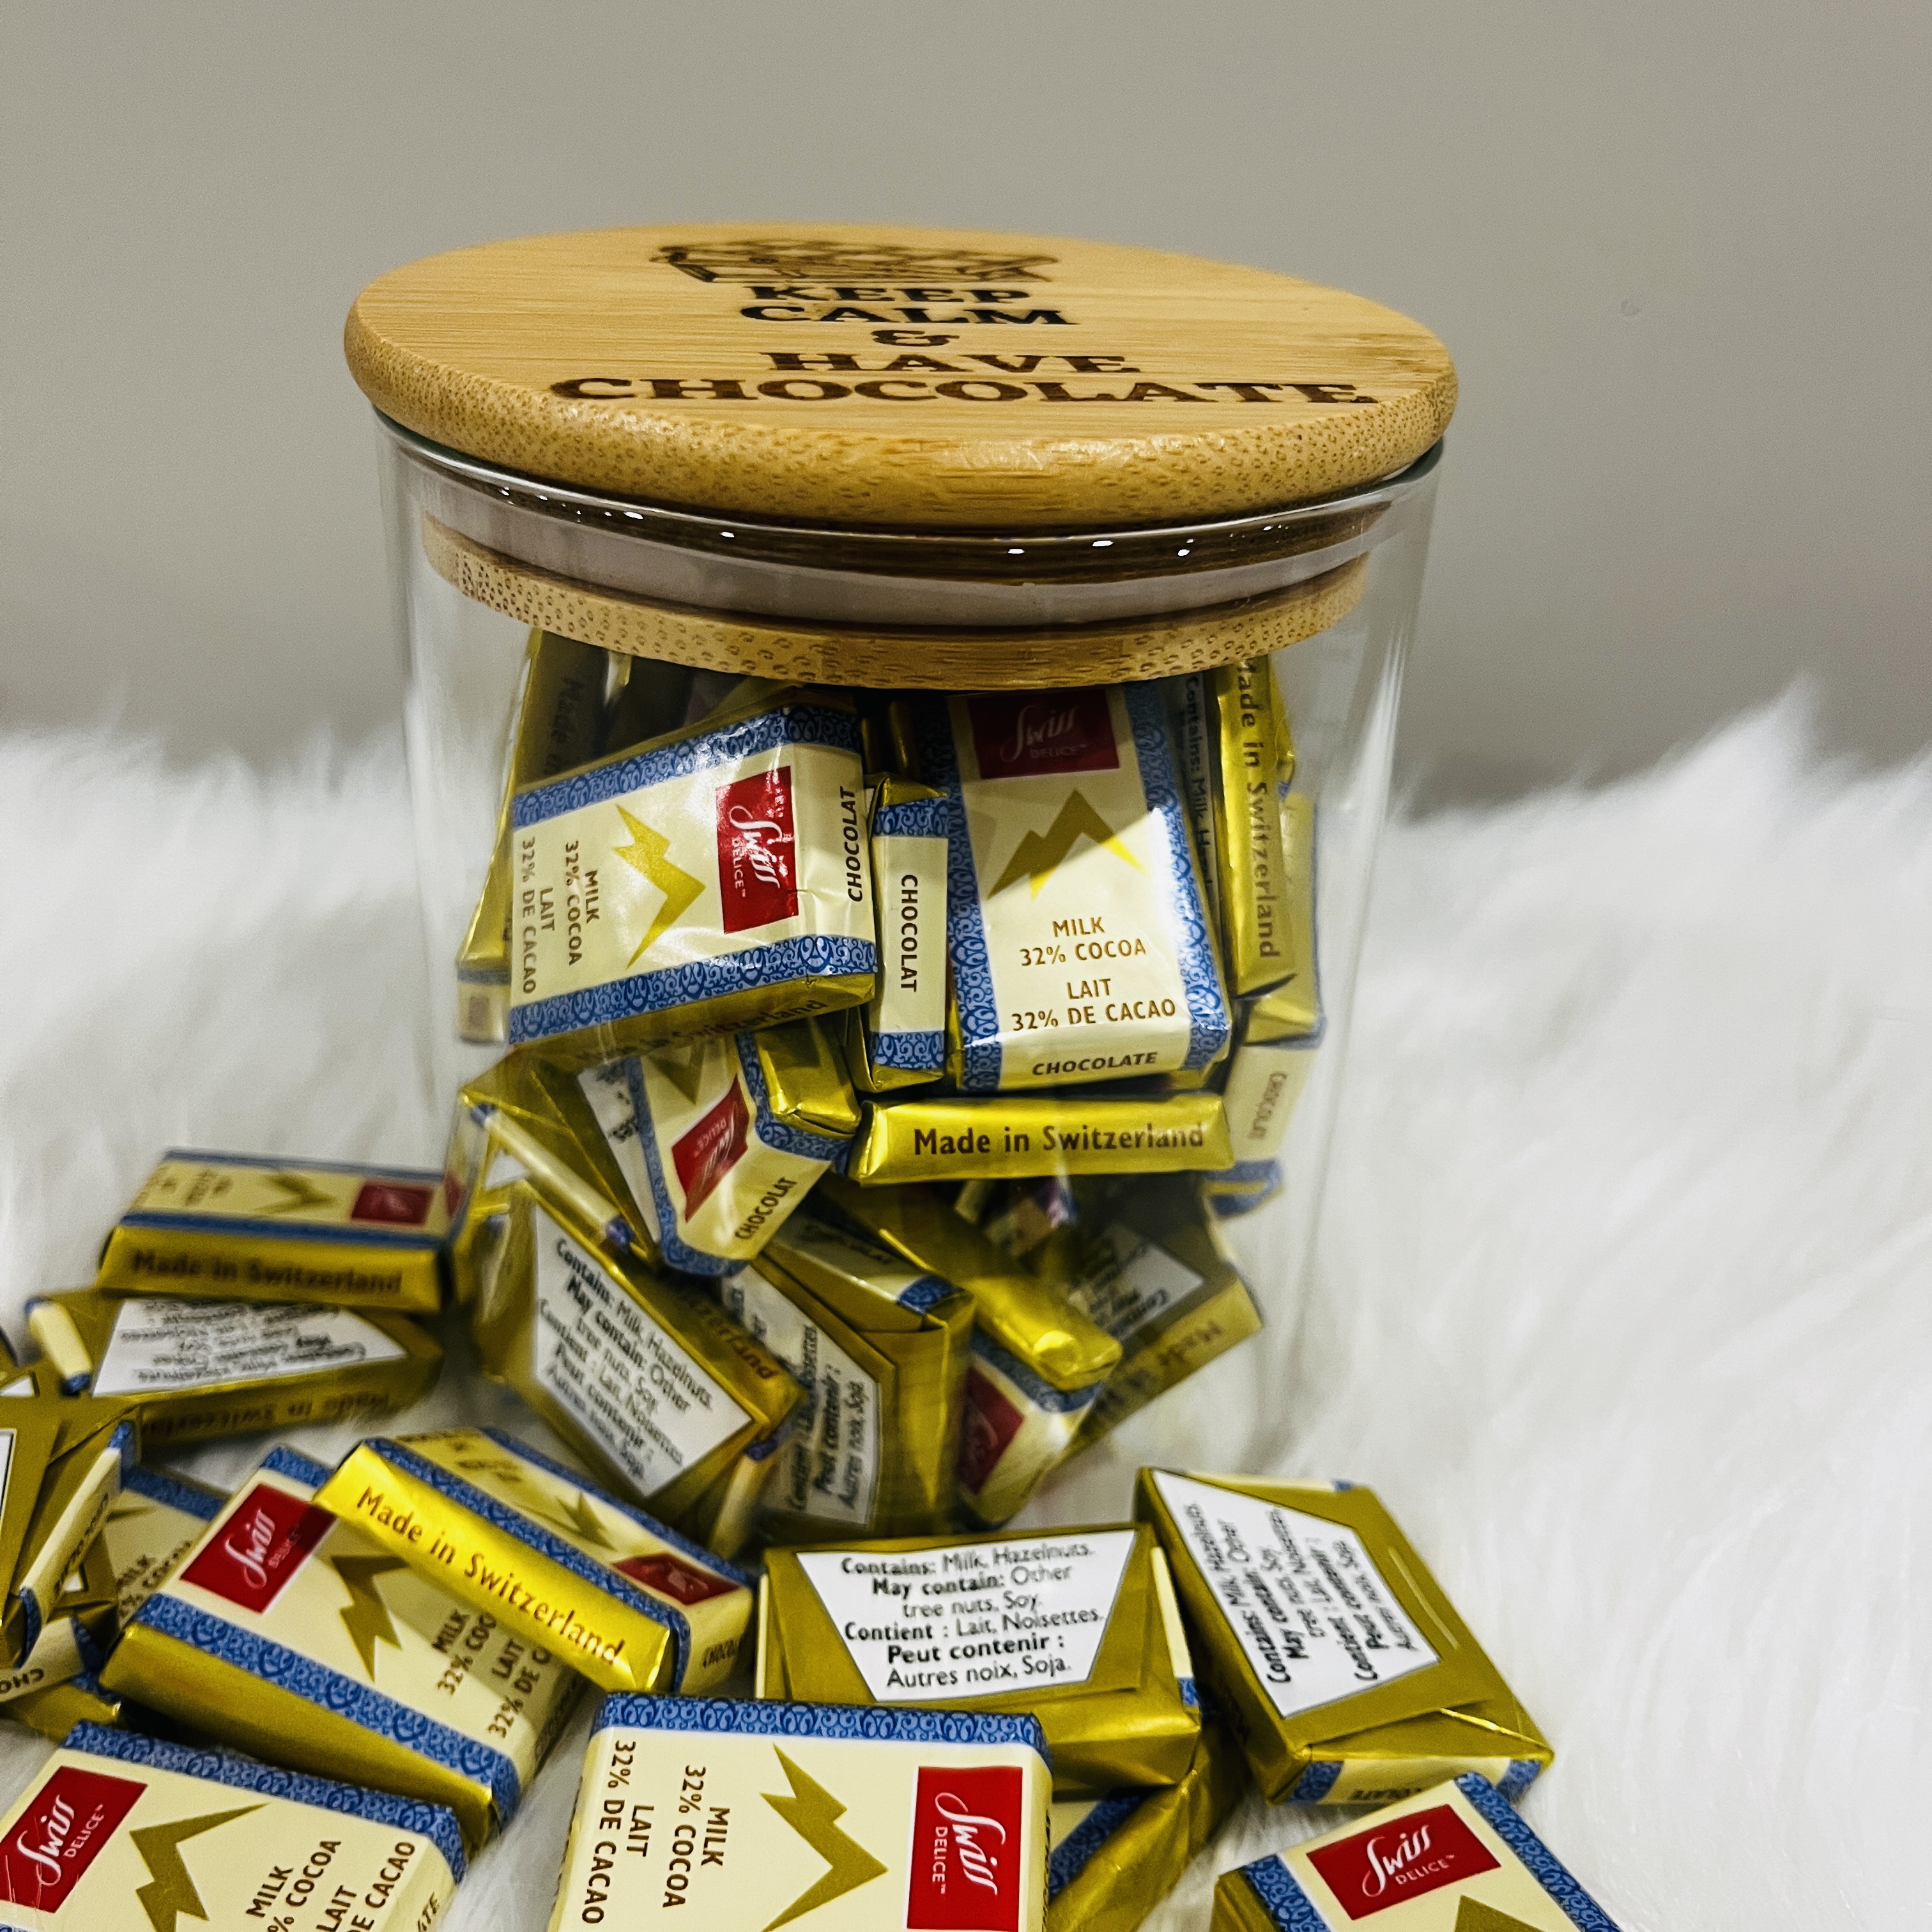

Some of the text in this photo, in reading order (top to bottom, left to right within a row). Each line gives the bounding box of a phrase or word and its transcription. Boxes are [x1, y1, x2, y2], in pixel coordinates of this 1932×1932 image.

[740, 306, 1080, 325] CALM
[745, 286, 1030, 303] KEEP
[761, 352, 1141, 372] HAVE
[871, 330, 960, 346] &
[550, 378, 1380, 404] CHOCOLATE
[999, 705, 1078, 763] Swiss
[1243, 741, 1264, 767] in
[727, 804, 783, 889] Swiss
[839, 785, 862, 902] CHOCOLAT
[1246, 781, 1280, 958] Switzerland
[521, 836, 537, 994] 32% DE CACAO
[540, 887, 555, 931] LAIT
[565, 840, 582, 966] 32% COCOA
[585, 870, 600, 924] MILK
[901, 874, 919, 992] CHOCOLAT
[1019, 938, 1146, 967] 32% COCOA
[1052, 917, 1105, 937] MILK
[1011, 998, 1176, 1031] 32% DE CACAO
[1066, 978, 1111, 1000] LAIT
[1032, 1052, 1158, 1075] CHOCOLATE
[914, 1124, 1204, 1155] Made in Switzerland
[735, 1177, 797, 1240] CHOCOLAT
[224, 1505, 275, 1590] Swiss
[841, 1557, 937, 1575] Contains:
[356, 1485, 424, 1544] Made
[429, 1531, 457, 1565] in
[463, 1552, 627, 1666] Switzerland
[873, 1576, 912, 1600] May
[922, 1571, 1005, 1595] contain:
[432, 1609, 470, 1653] MILK
[844, 1620, 933, 1641] Contient
[902, 1603, 944, 1618] tree
[436, 1612, 496, 1696] 32% COC
[491, 1637, 525, 1678] LAIT
[887, 1644, 940, 1664] Peut
[949, 1632, 1050, 1660] contenir
[887, 1653, 1072, 1688] Autres noix, Soja.
[487, 1666, 540, 1738] 32% DE
[16, 1793, 75, 1887] Swiss
[581, 1740, 636, 1924] 32% DE CACAO
[626, 1805, 655, 1857] LAIT
[663, 1764, 706, 1908] 32% COCOA
[700, 1807, 731, 1866] MILK
[935, 1792, 1007, 1896] Swiss
[286, 1840, 342, 1908] COCOA
[365, 1841, 416, 1909] CACAO
[1361, 1825, 1432, 1898] Swiss
[245, 1866, 295, 1919] MILK
